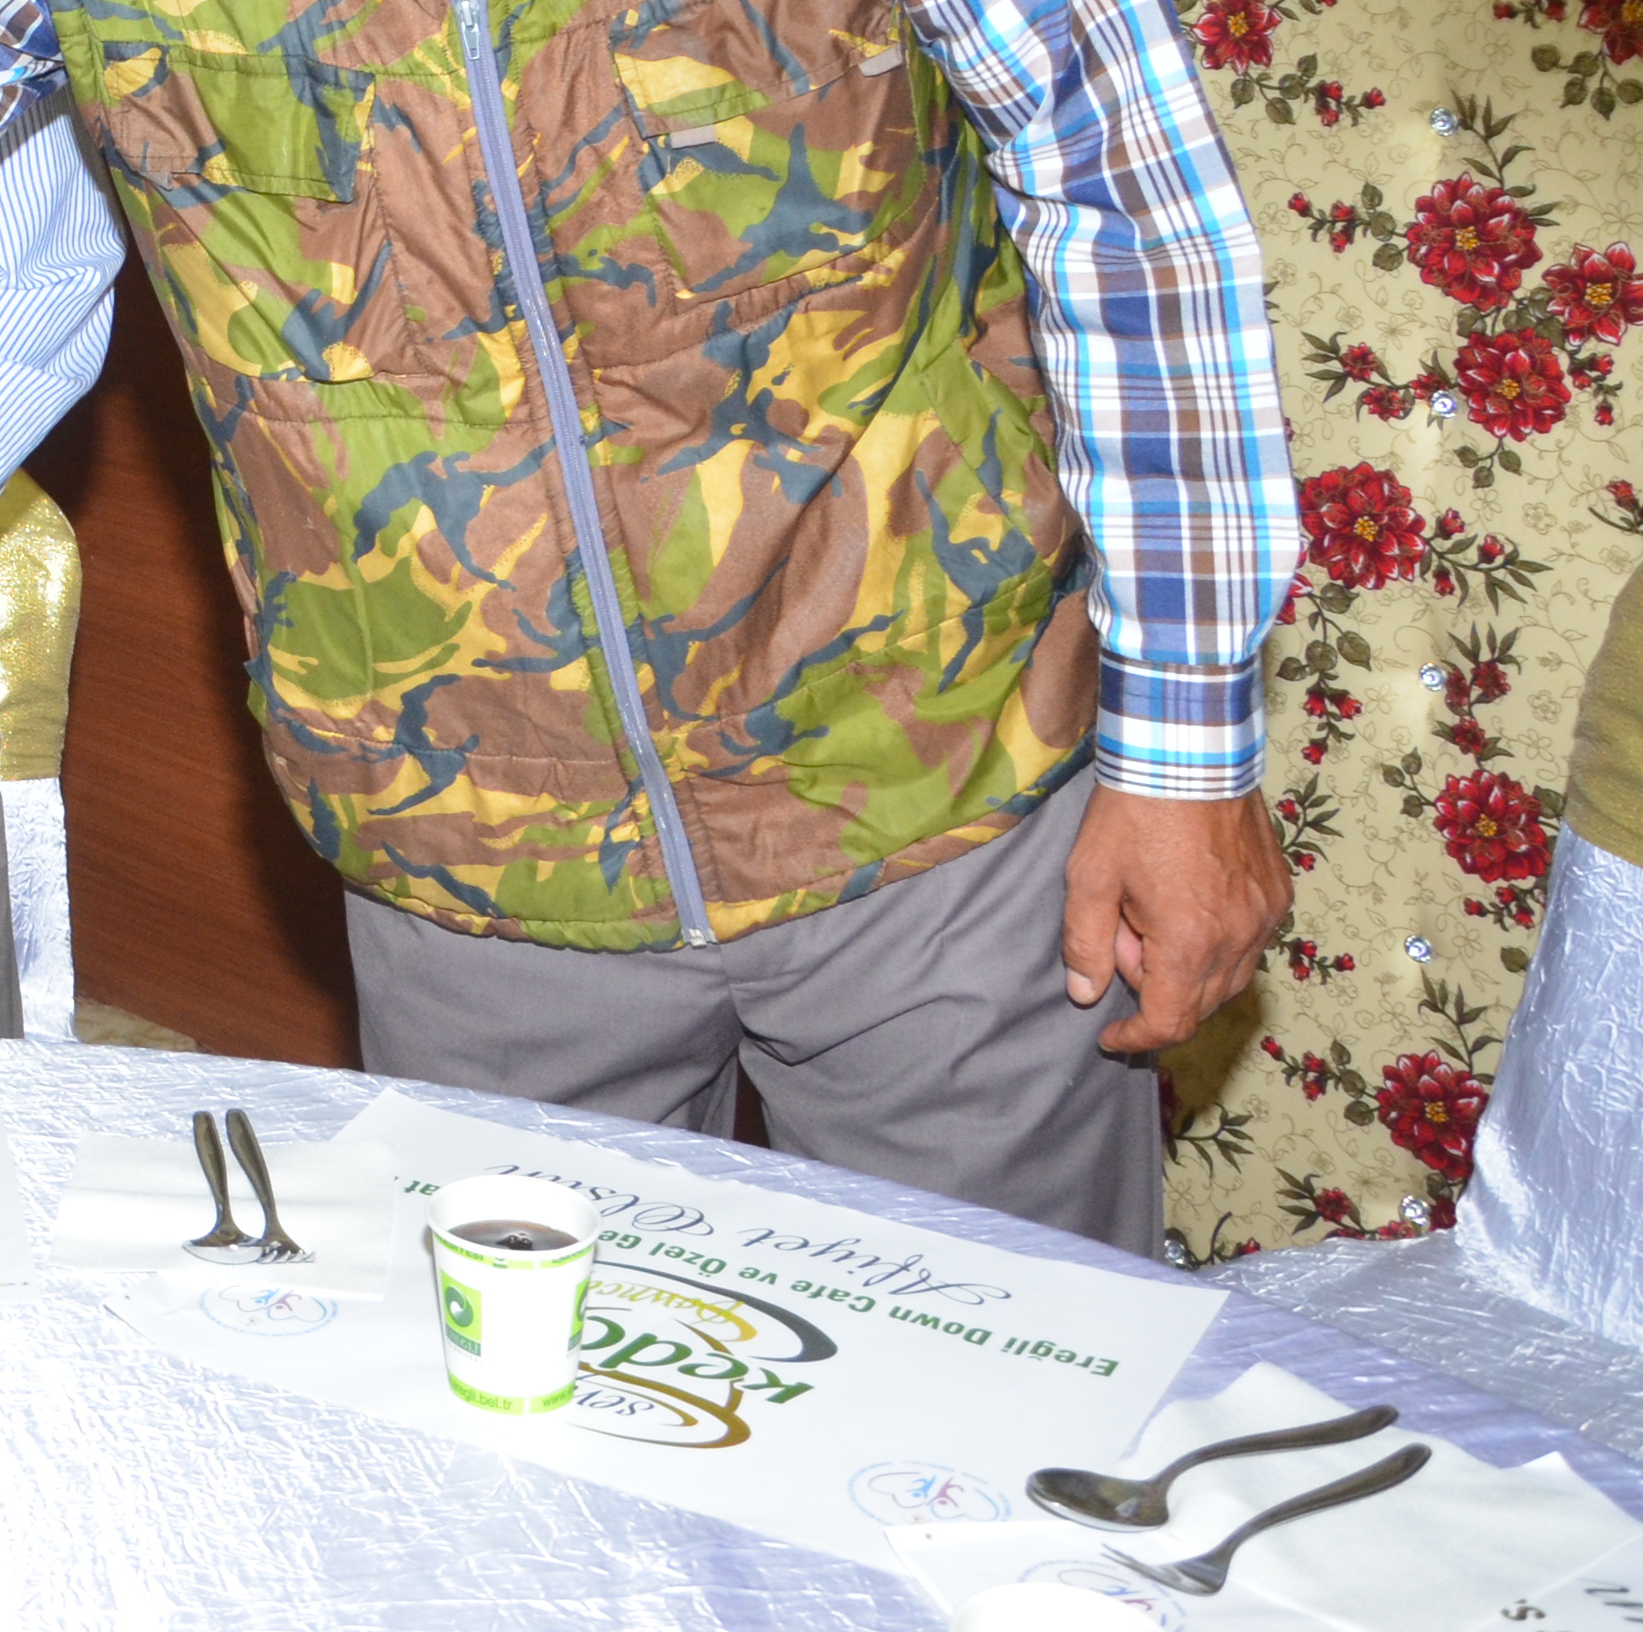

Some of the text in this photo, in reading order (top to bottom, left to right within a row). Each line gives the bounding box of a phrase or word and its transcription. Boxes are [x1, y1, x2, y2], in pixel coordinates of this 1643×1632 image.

[648, 1242, 1120, 1378] Ereğli Down Cafe ve Özel
[737, 1228, 1012, 1306] Afiyet
